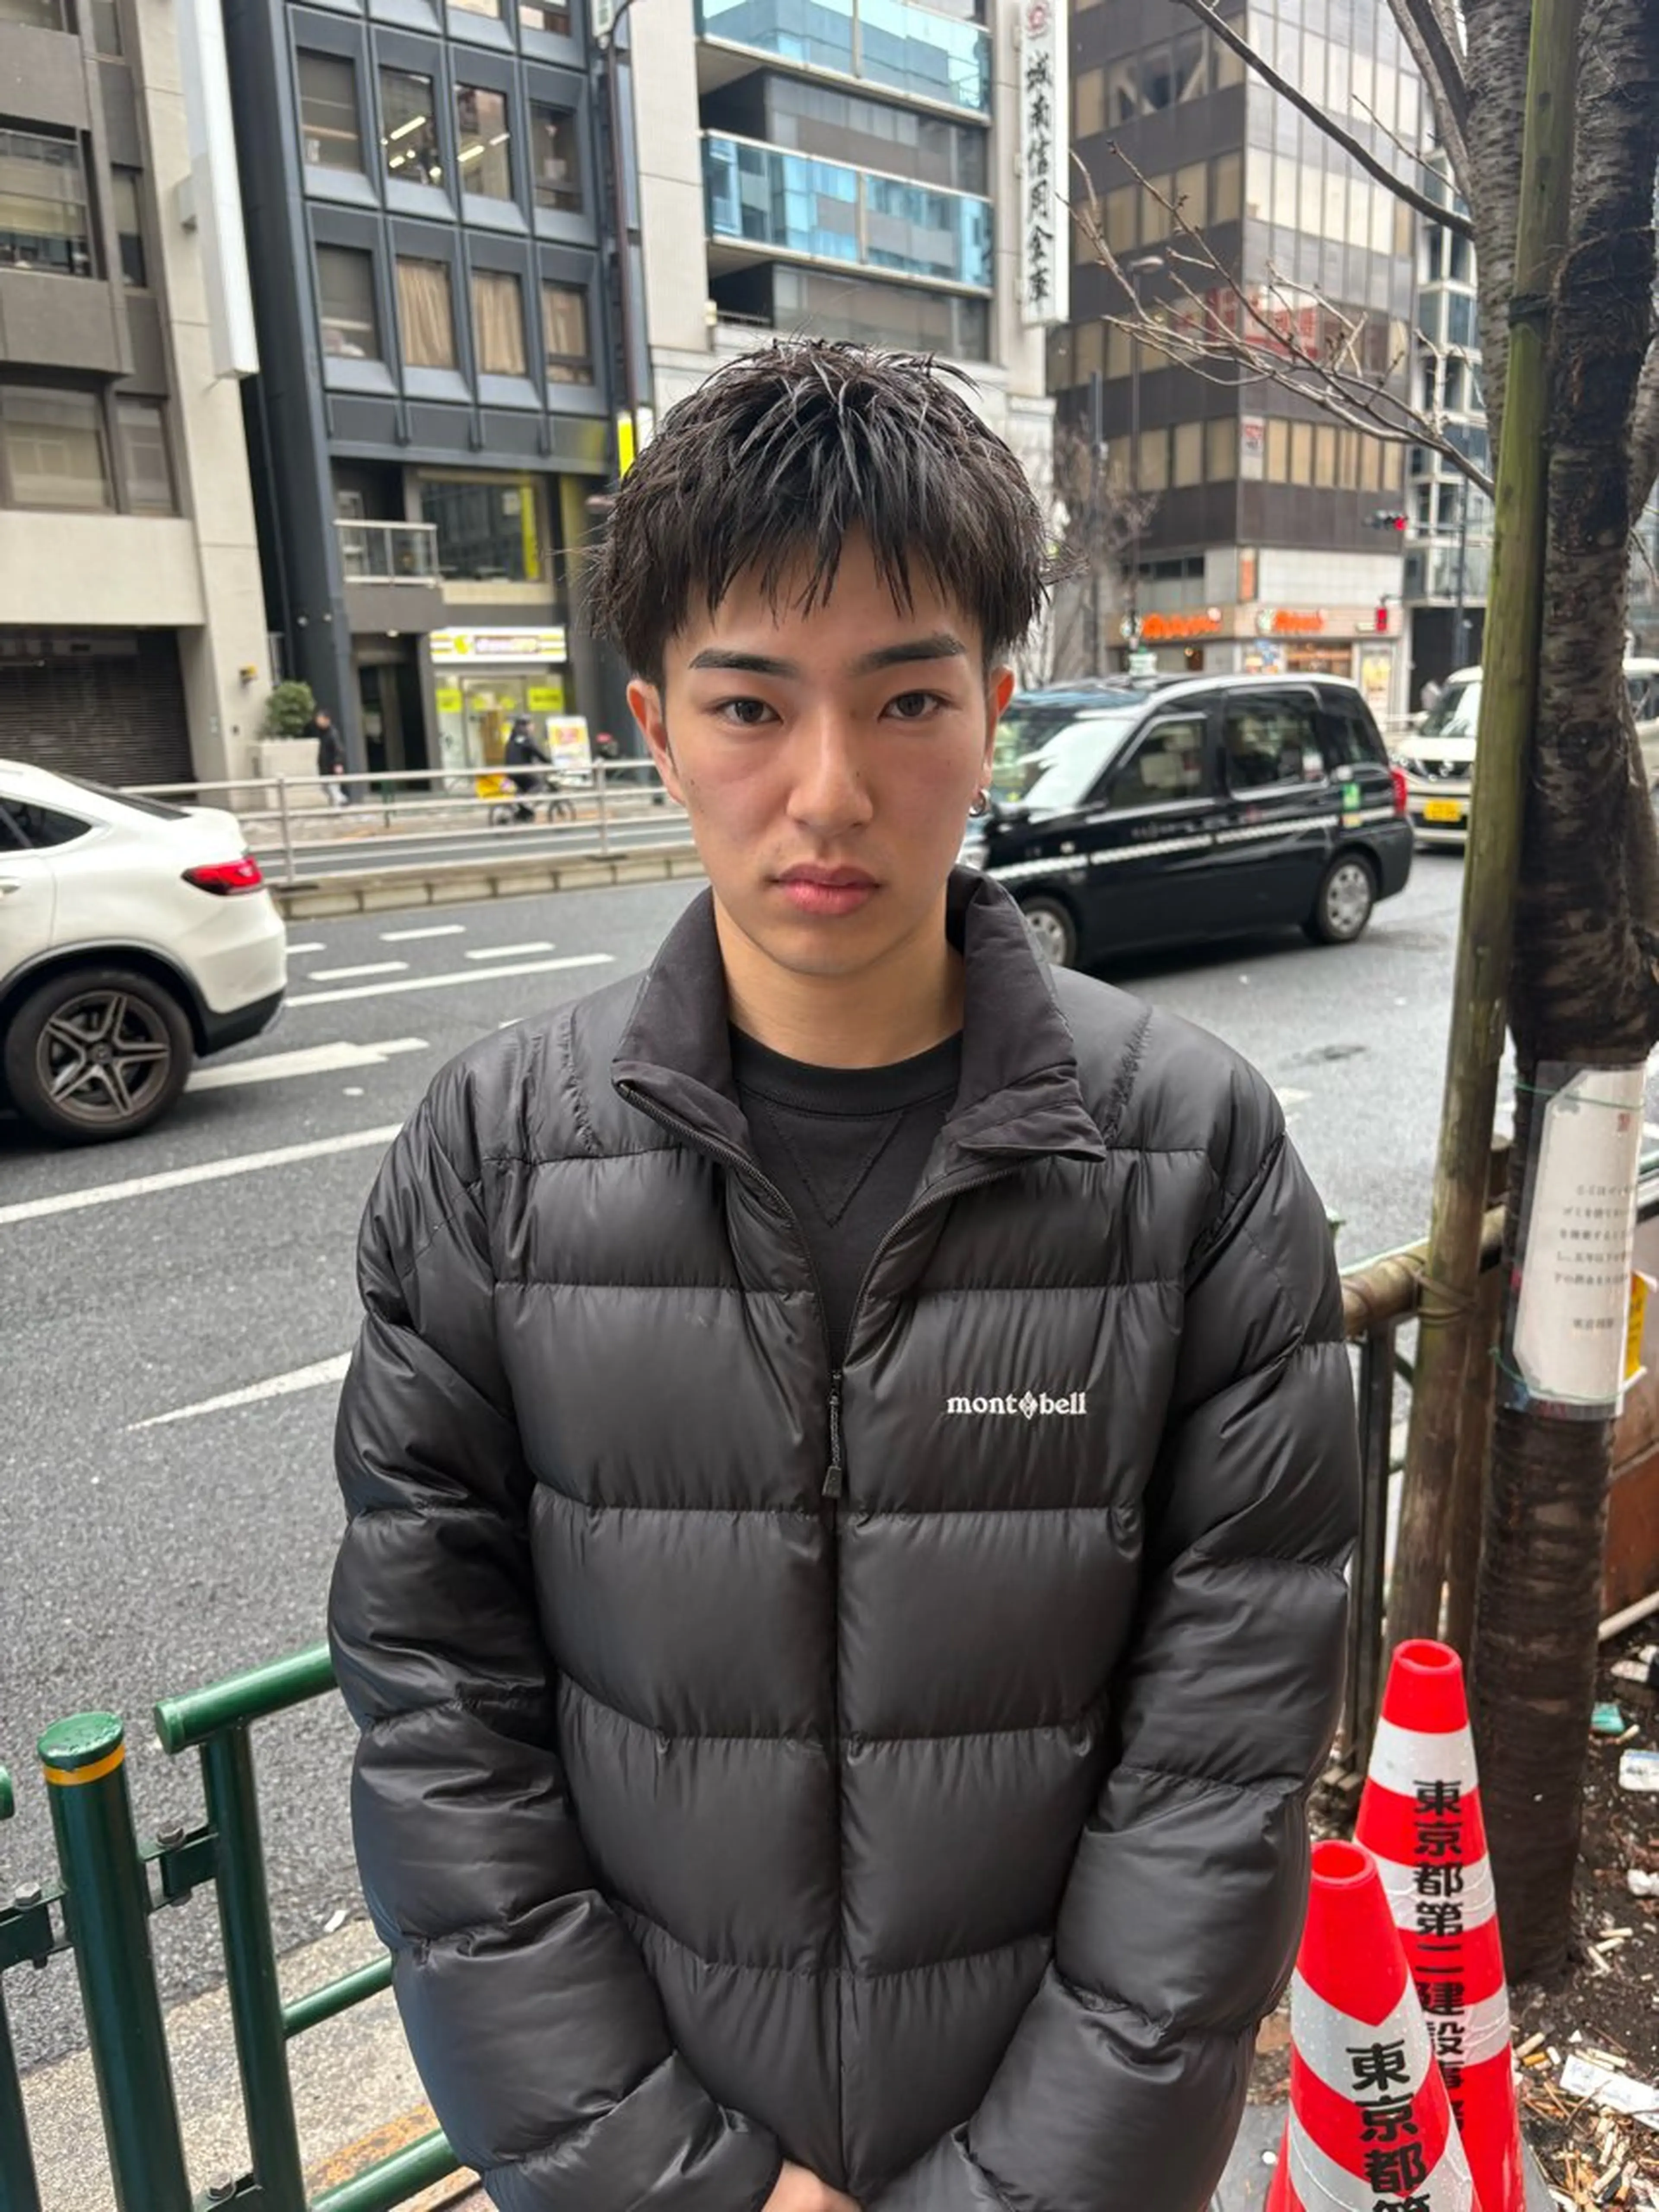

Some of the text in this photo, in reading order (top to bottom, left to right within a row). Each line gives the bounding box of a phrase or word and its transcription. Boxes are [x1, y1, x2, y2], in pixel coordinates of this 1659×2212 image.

[1026, 49, 1053, 310] 城南信用金庫
